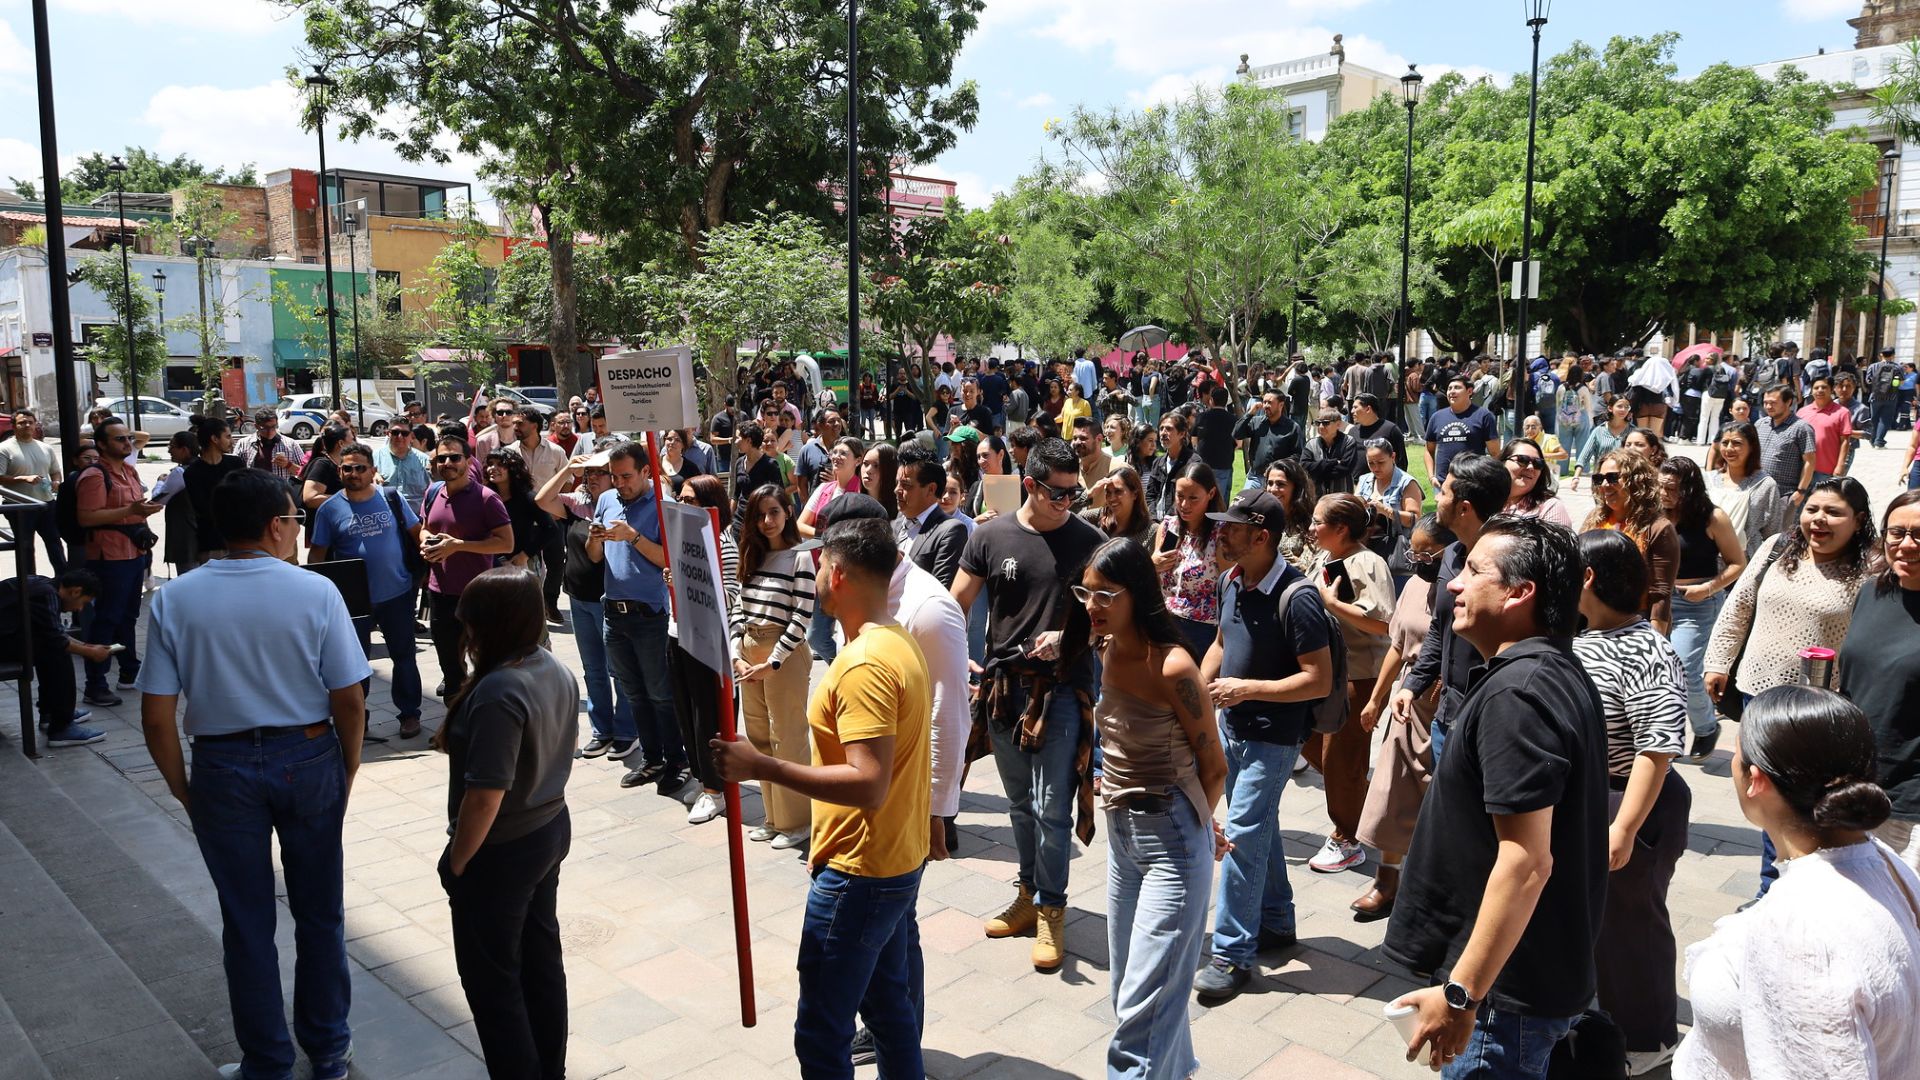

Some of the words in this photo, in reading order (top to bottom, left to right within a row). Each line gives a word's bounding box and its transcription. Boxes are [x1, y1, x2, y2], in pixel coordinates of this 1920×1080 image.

[608, 367, 671, 380] DESPACHO
[637, 381, 672, 389] Institucional
[348, 510, 391, 531] Aero
[361, 529, 383, 538] Original
